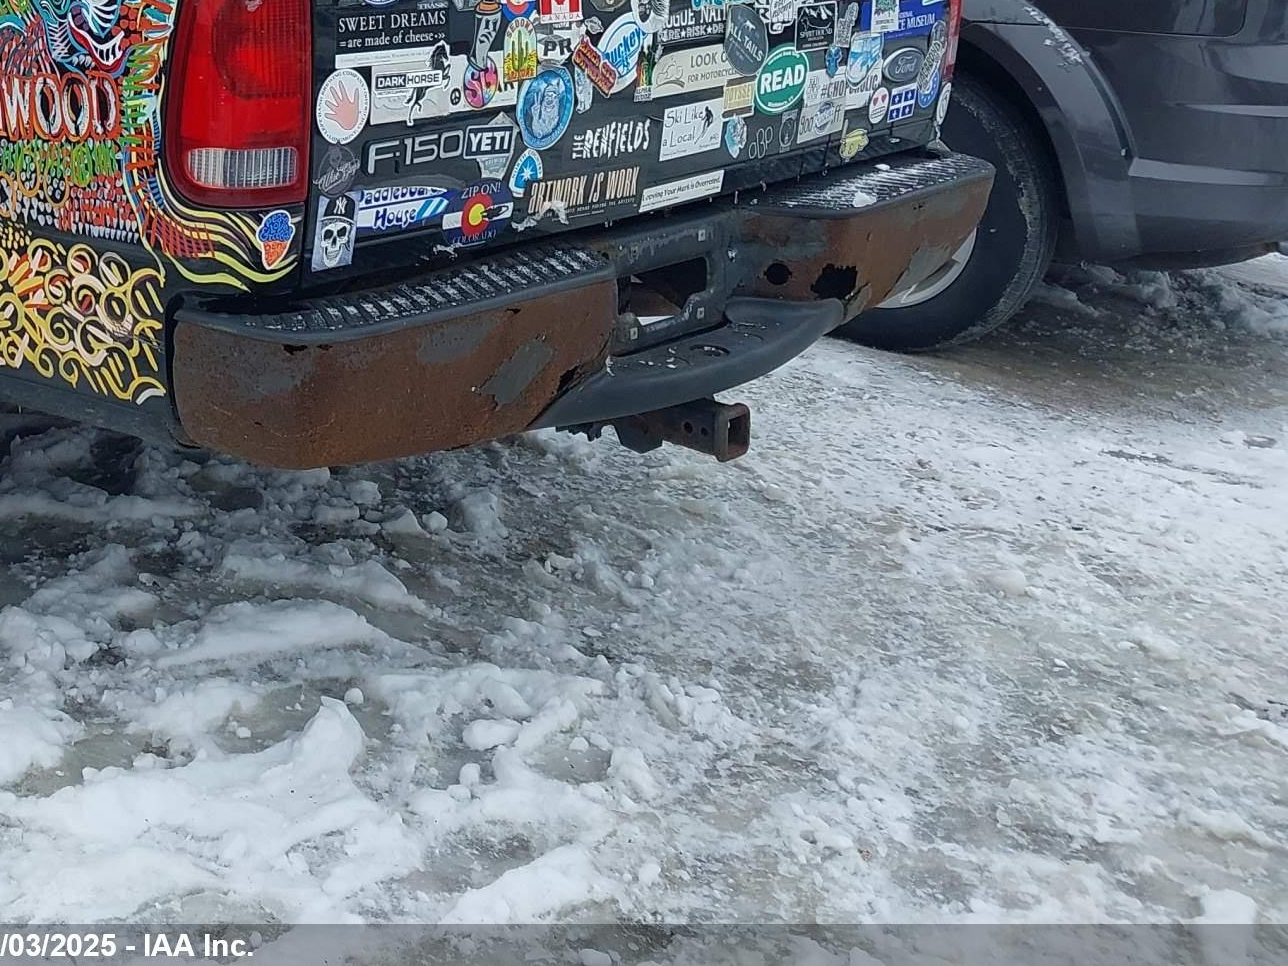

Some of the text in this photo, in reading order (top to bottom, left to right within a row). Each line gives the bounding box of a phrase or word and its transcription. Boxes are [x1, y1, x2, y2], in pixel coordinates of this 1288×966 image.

[339, 10, 446, 33] SWEET DREAMS
[540, 12, 582, 22] CANADA
[663, 8, 696, 29] OGUE
[907, 13, 936, 30] MUSEUM
[347, 29, 434, 48] are made of cheese
[743, 35, 764, 62] TAILS
[690, 52, 718, 69] LOOK
[895, 56, 917, 74] Ford
[377, 73, 441, 88] DARK HORSE
[687, 68, 739, 83] FOR MOTORCYCL
[760, 64, 805, 94] READ
[665, 106, 704, 128] Ski Like
[469, 131, 511, 152] YETI
[662, 126, 696, 147] a Local
[462, 182, 501, 200] ZIP ON!
[528, 166, 640, 214] ARTWORK IS WORK
[373, 207, 416, 230] House
